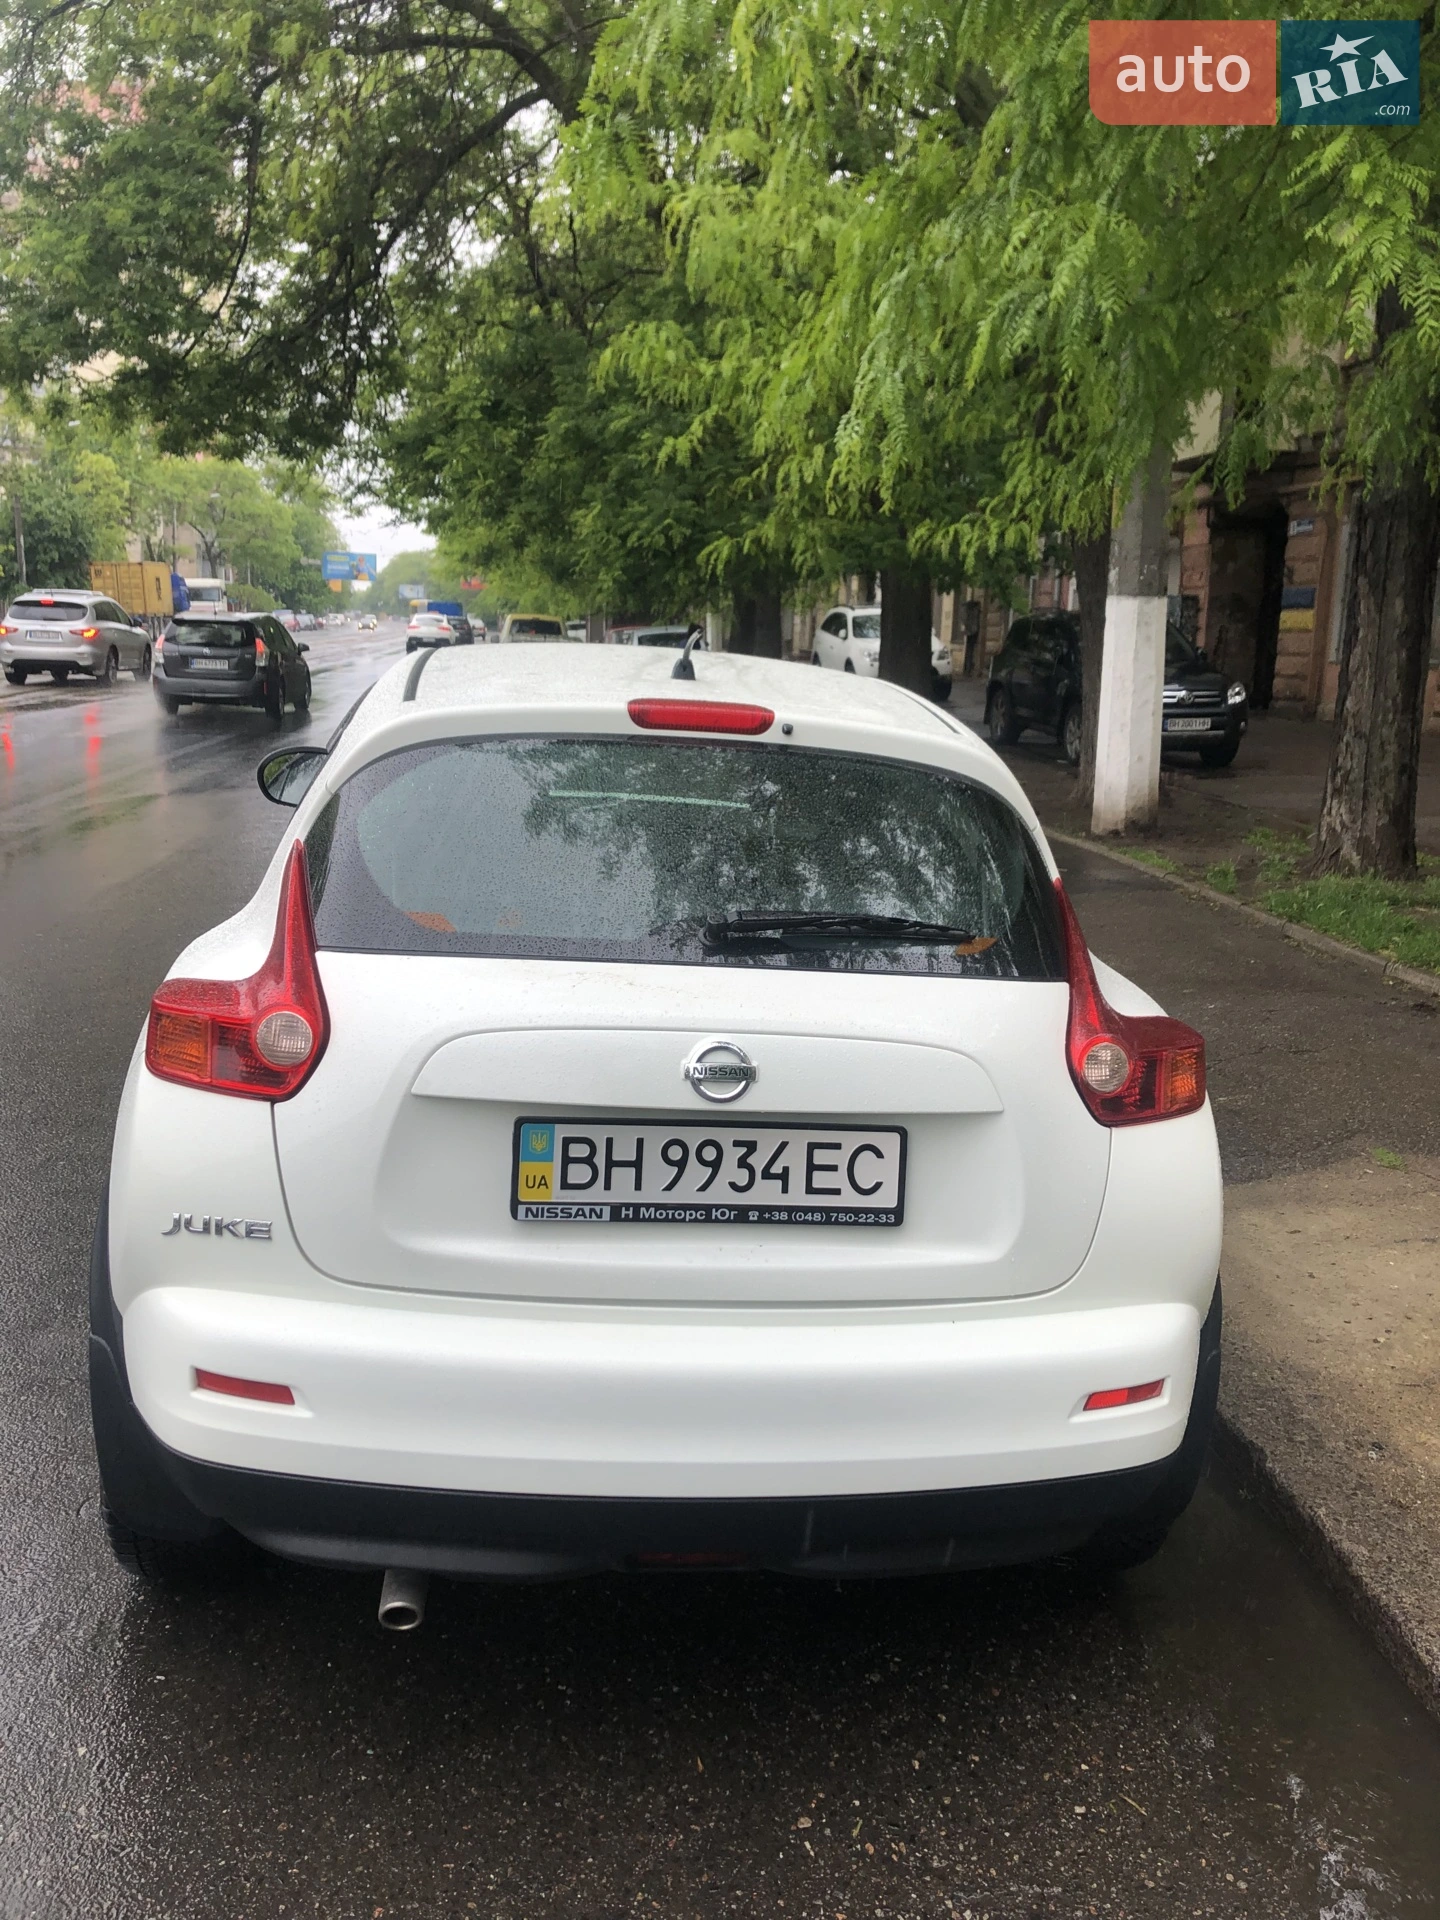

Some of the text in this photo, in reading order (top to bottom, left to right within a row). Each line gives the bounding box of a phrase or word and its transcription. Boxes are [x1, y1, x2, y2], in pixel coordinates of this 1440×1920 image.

[693, 1066, 749, 1077] NISSAN
[559, 1136, 885, 1197] BH 9934 EC
[525, 1174, 549, 1190] UA
[524, 1206, 603, 1220] NISSAN
[640, 1208, 706, 1222] Моторс
[711, 1208, 738, 1221] Юг
[763, 1211, 895, 1223] +38 (048) 750-22-33
[161, 1212, 273, 1240] JUKE
